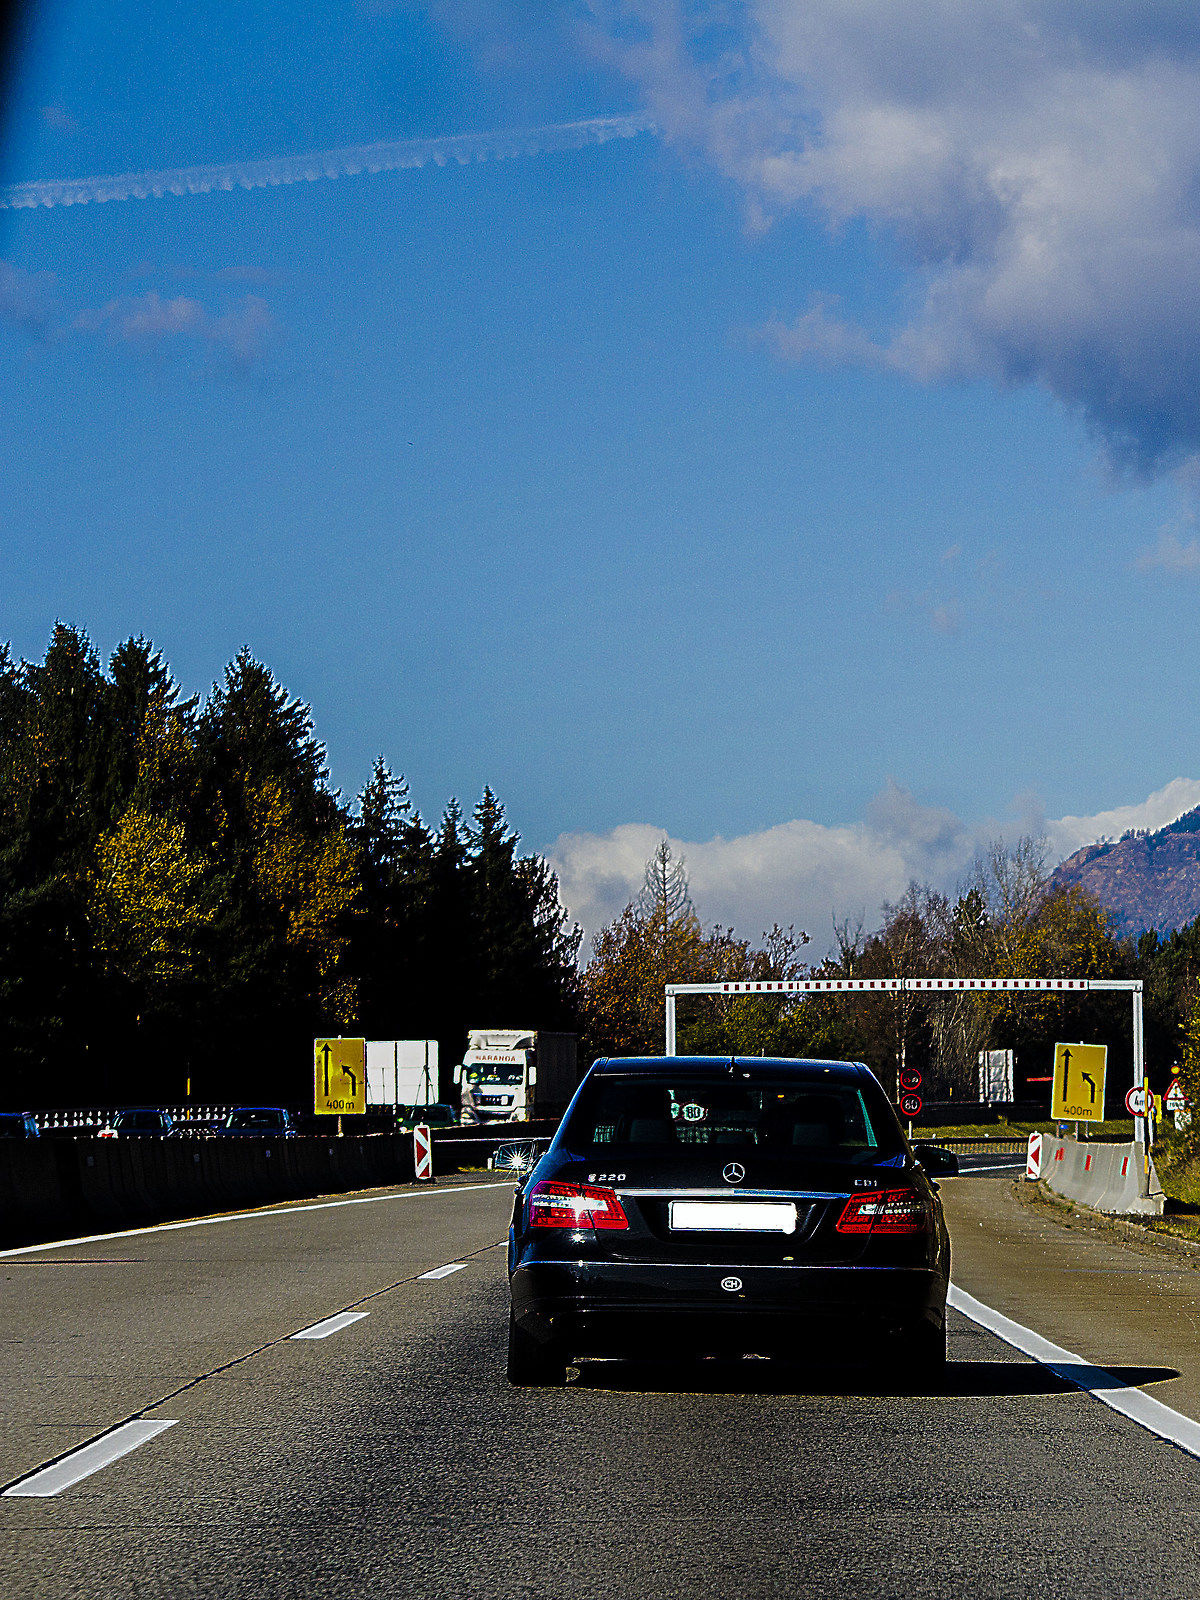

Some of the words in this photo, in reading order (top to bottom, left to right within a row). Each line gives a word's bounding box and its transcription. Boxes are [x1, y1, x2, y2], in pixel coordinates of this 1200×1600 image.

[326, 1099, 355, 1110] 400m
[1063, 1105, 1093, 1116] 400m
[598, 1173, 627, 1182] 220
[724, 1279, 738, 1288] CH
